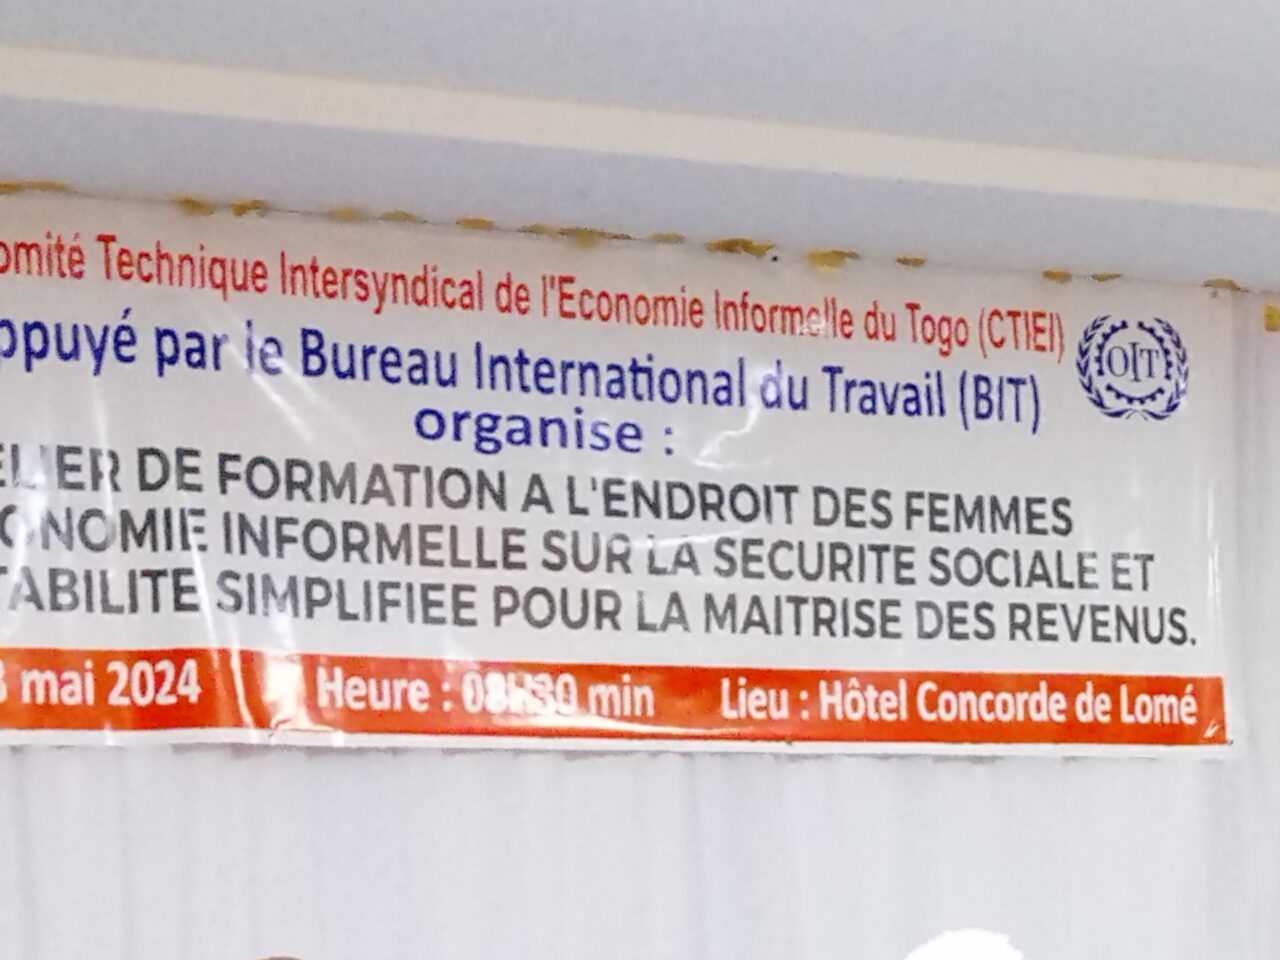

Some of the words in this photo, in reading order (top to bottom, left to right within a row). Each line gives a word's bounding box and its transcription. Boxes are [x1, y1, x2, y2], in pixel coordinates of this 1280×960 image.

[96, 234, 268, 300] Technique
[280, 251, 484, 314] Intersyndical
[495, 272, 530, 315] de
[543, 274, 705, 328] l'Economie
[714, 297, 854, 340] Informelle
[864, 301, 899, 343] du
[905, 303, 969, 357] Togo
[979, 308, 1066, 362] (CTIEI)
[156, 325, 228, 377] par
[246, 320, 284, 375] le
[301, 327, 457, 388] Bureau
[476, 341, 746, 407] International
[758, 358, 808, 409] du
[822, 366, 946, 417] Travail
[959, 369, 1040, 434] (BIT)
[1107, 342, 1159, 382] OIT
[415, 407, 642, 456] organise
[663, 426, 674, 455] :
[137, 447, 203, 492] DE
[218, 453, 508, 510] FORMATION
[521, 474, 555, 515] A
[567, 475, 798, 526] L'ENDROIT
[813, 487, 893, 529] DES
[906, 491, 1073, 537] FEMMES
[223, 511, 527, 571] INFORMELLE
[541, 529, 632, 575] SUR
[647, 535, 699, 576] LA
[713, 537, 916, 587] SECURITE
[929, 545, 1098, 590] SOCIALE
[1112, 552, 1155, 592] ET
[216, 570, 477, 627] SIMPLIFIEE
[494, 584, 622, 632] POUR
[636, 589, 691, 634] LA
[704, 592, 902, 639] MAITRISE
[917, 600, 997, 642] DES
[1009, 603, 1197, 647] REVENUS.
[21, 658, 95, 706] mai
[106, 658, 202, 706] 2024
[317, 664, 430, 713] Heure
[441, 681, 452, 713] :
[588, 673, 654, 717] min
[720, 677, 790, 720] Lieu
[800, 690, 809, 722] :
[820, 677, 908, 724] Hôtel
[916, 681, 1065, 724] Concorde
[1074, 684, 1112, 725] de
[1120, 683, 1198, 726] Lomé
